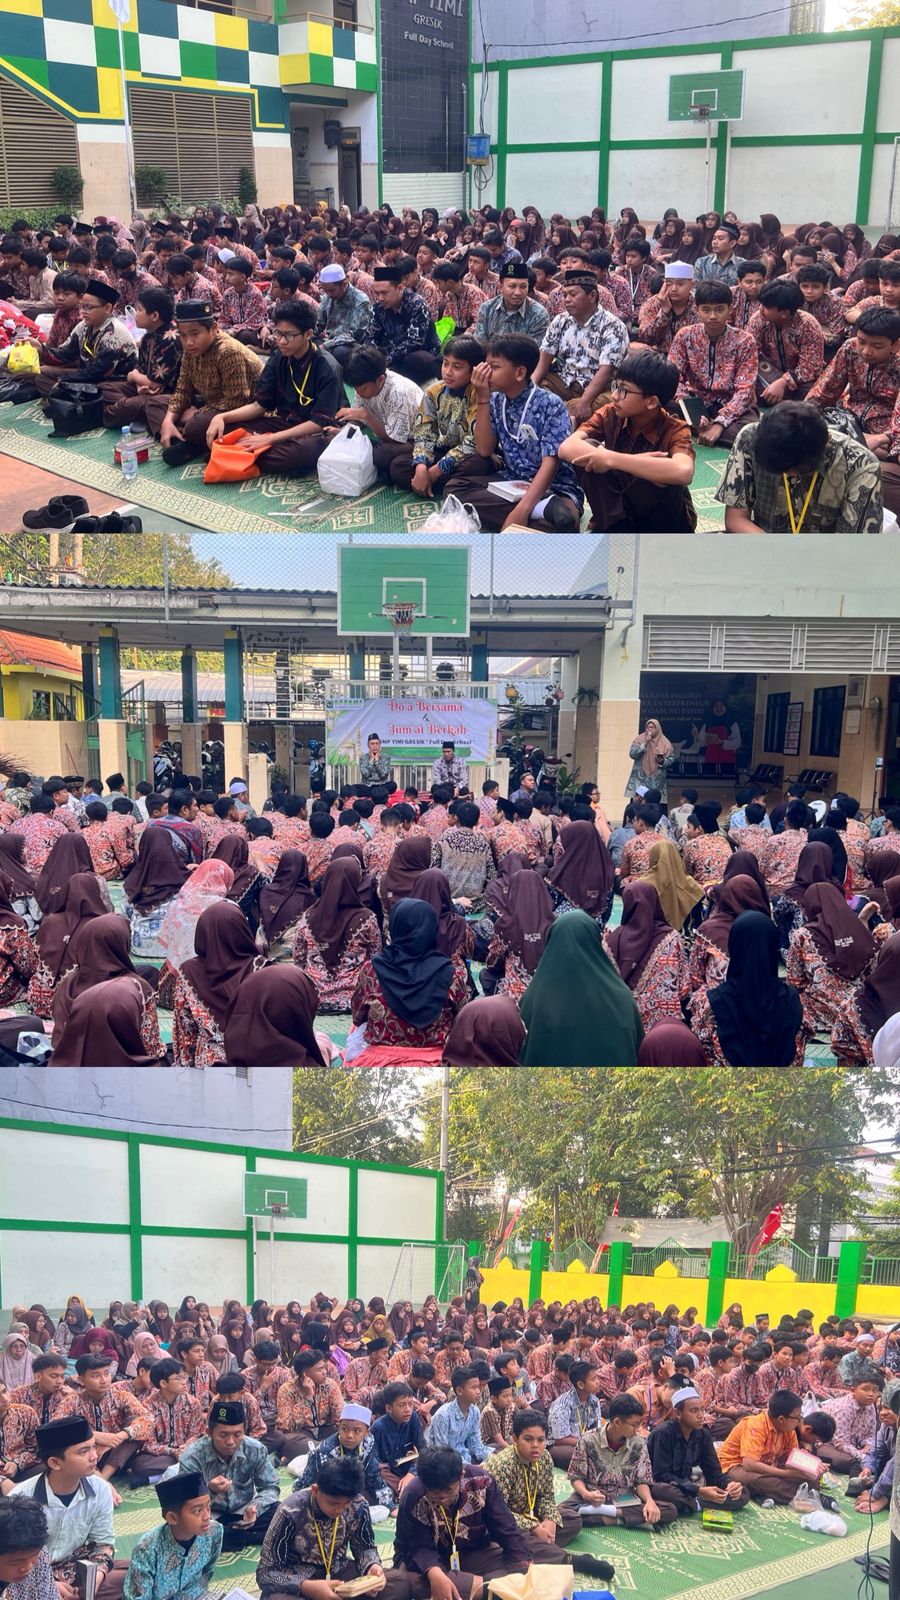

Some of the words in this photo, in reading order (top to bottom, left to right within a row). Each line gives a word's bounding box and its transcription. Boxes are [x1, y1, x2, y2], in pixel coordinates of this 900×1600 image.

[413, 13, 443, 30] GRESIK
[404, 31, 418, 41] Full
[419, 34, 432, 47] Day
[432, 38, 454, 51] School
[416, 699, 463, 712] Bersama
[389, 723, 424, 737] Jum'at
[427, 723, 467, 737] Berkah
